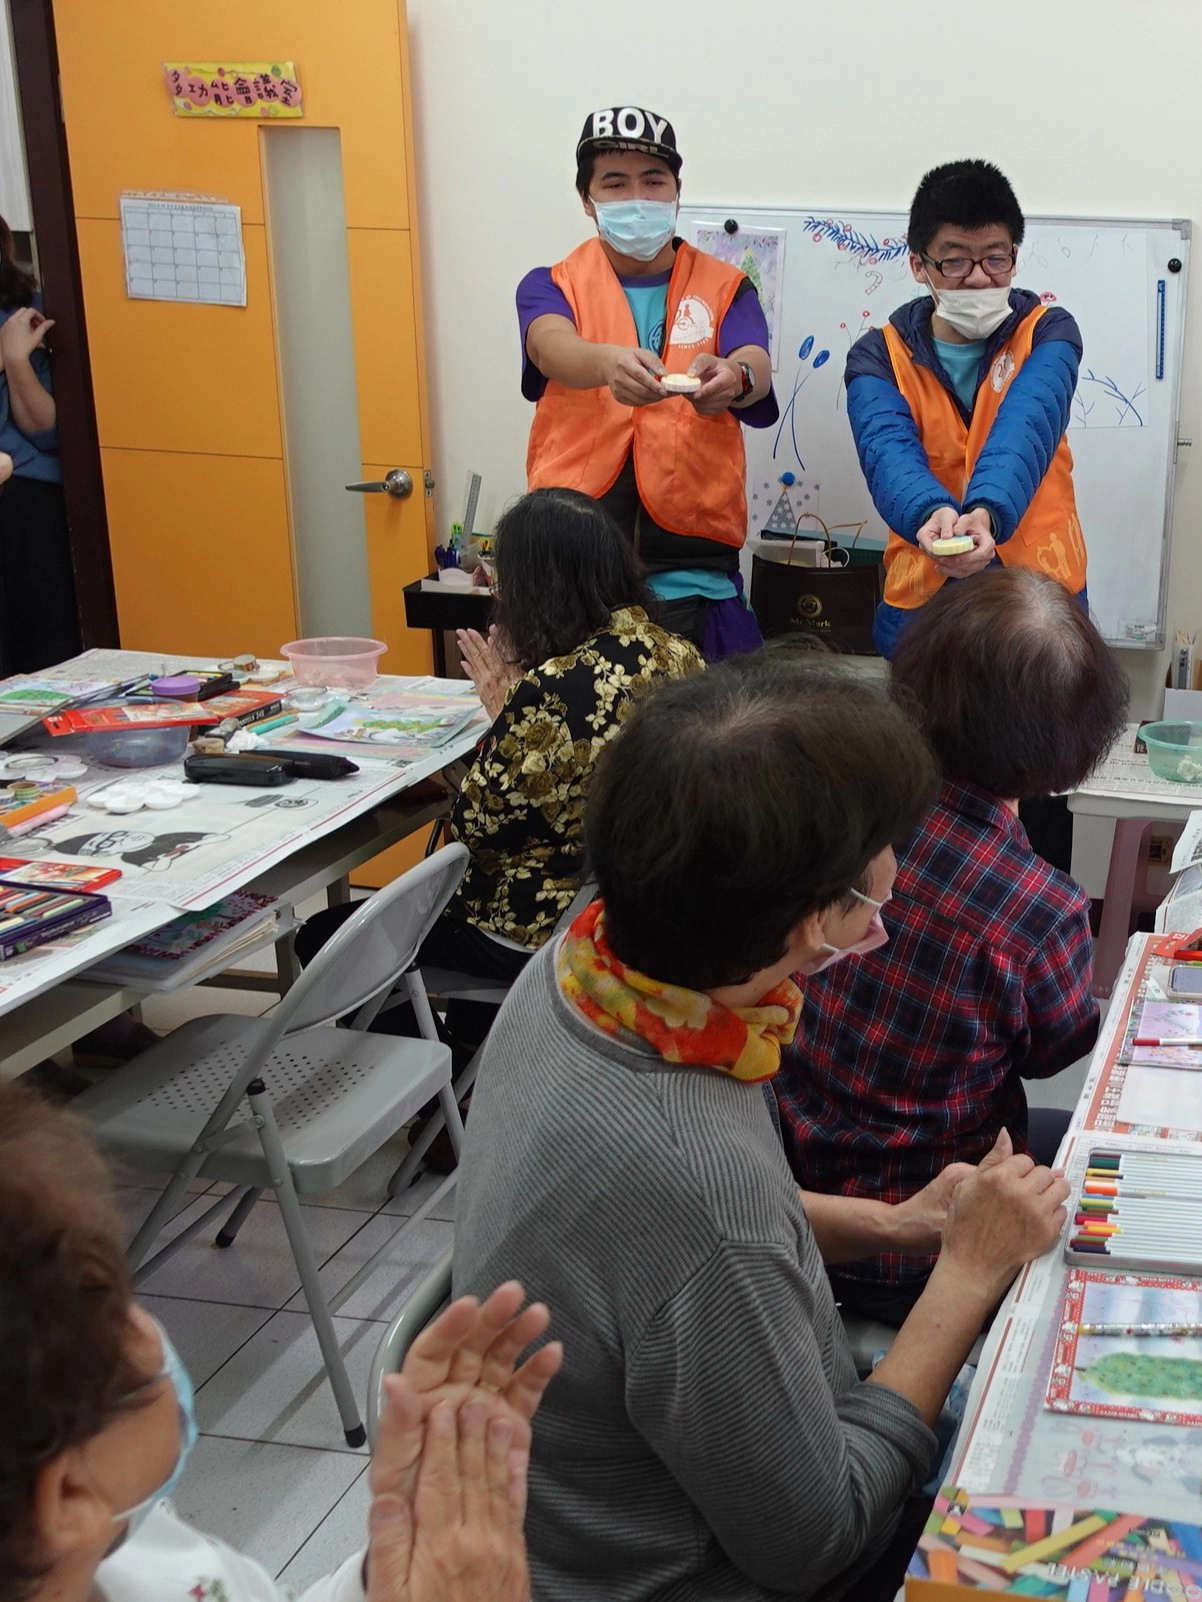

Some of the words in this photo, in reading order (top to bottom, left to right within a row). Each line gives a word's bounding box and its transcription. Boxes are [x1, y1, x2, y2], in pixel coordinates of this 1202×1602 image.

[172, 70, 298, 106] 多功能會議室
[592, 107, 668, 145] BOY
[1048, 1562, 1121, 1588] PASTEL
